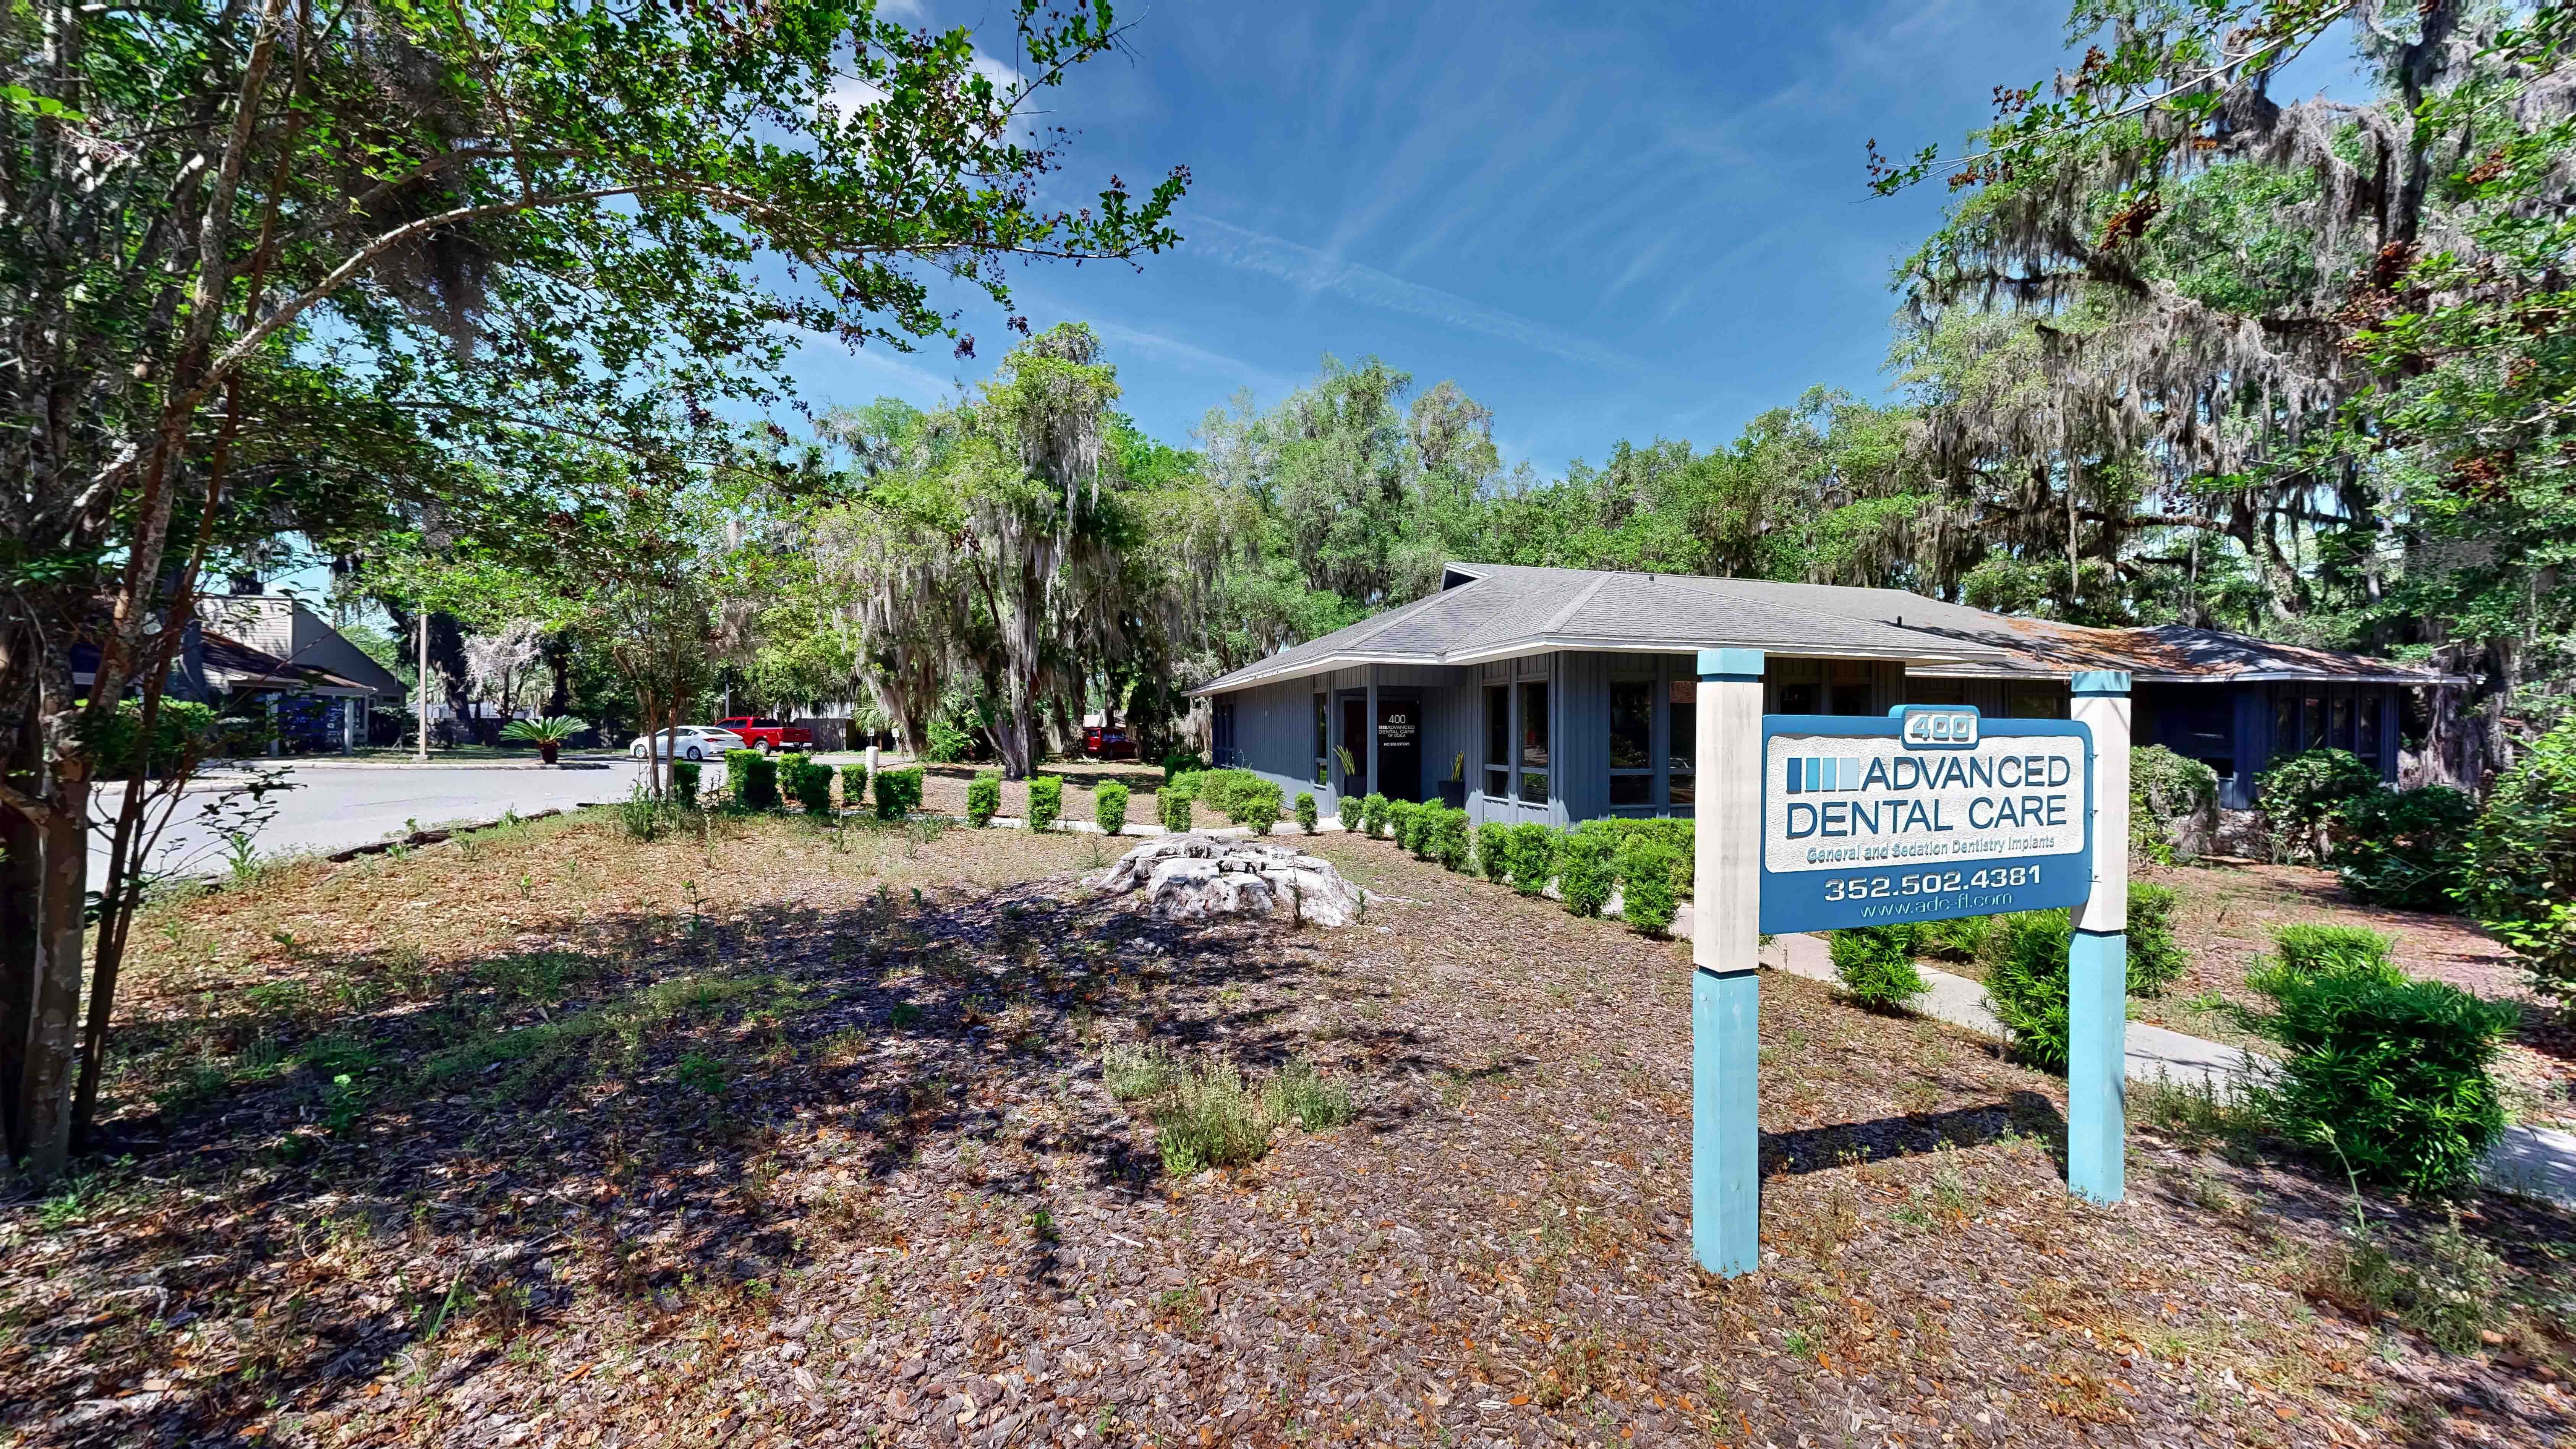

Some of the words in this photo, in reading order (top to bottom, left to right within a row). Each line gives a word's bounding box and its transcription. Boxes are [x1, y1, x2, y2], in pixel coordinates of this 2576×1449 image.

[1388, 715, 1406, 723] 400
[1911, 716, 1969, 741] 400
[1860, 755, 2070, 791] ADVANCED
[1786, 799, 1954, 840] DENTAL
[1968, 795, 2067, 829] CARE
[1806, 844, 1860, 864] General
[1864, 843, 1889, 861] and
[1892, 840, 1948, 858] Sedation
[1952, 838, 2005, 853] Dentistry
[2008, 835, 2054, 851] Implants
[1824, 864, 2040, 901] 352.502.4381
[1860, 893, 2012, 918] www.adc-fl.com
